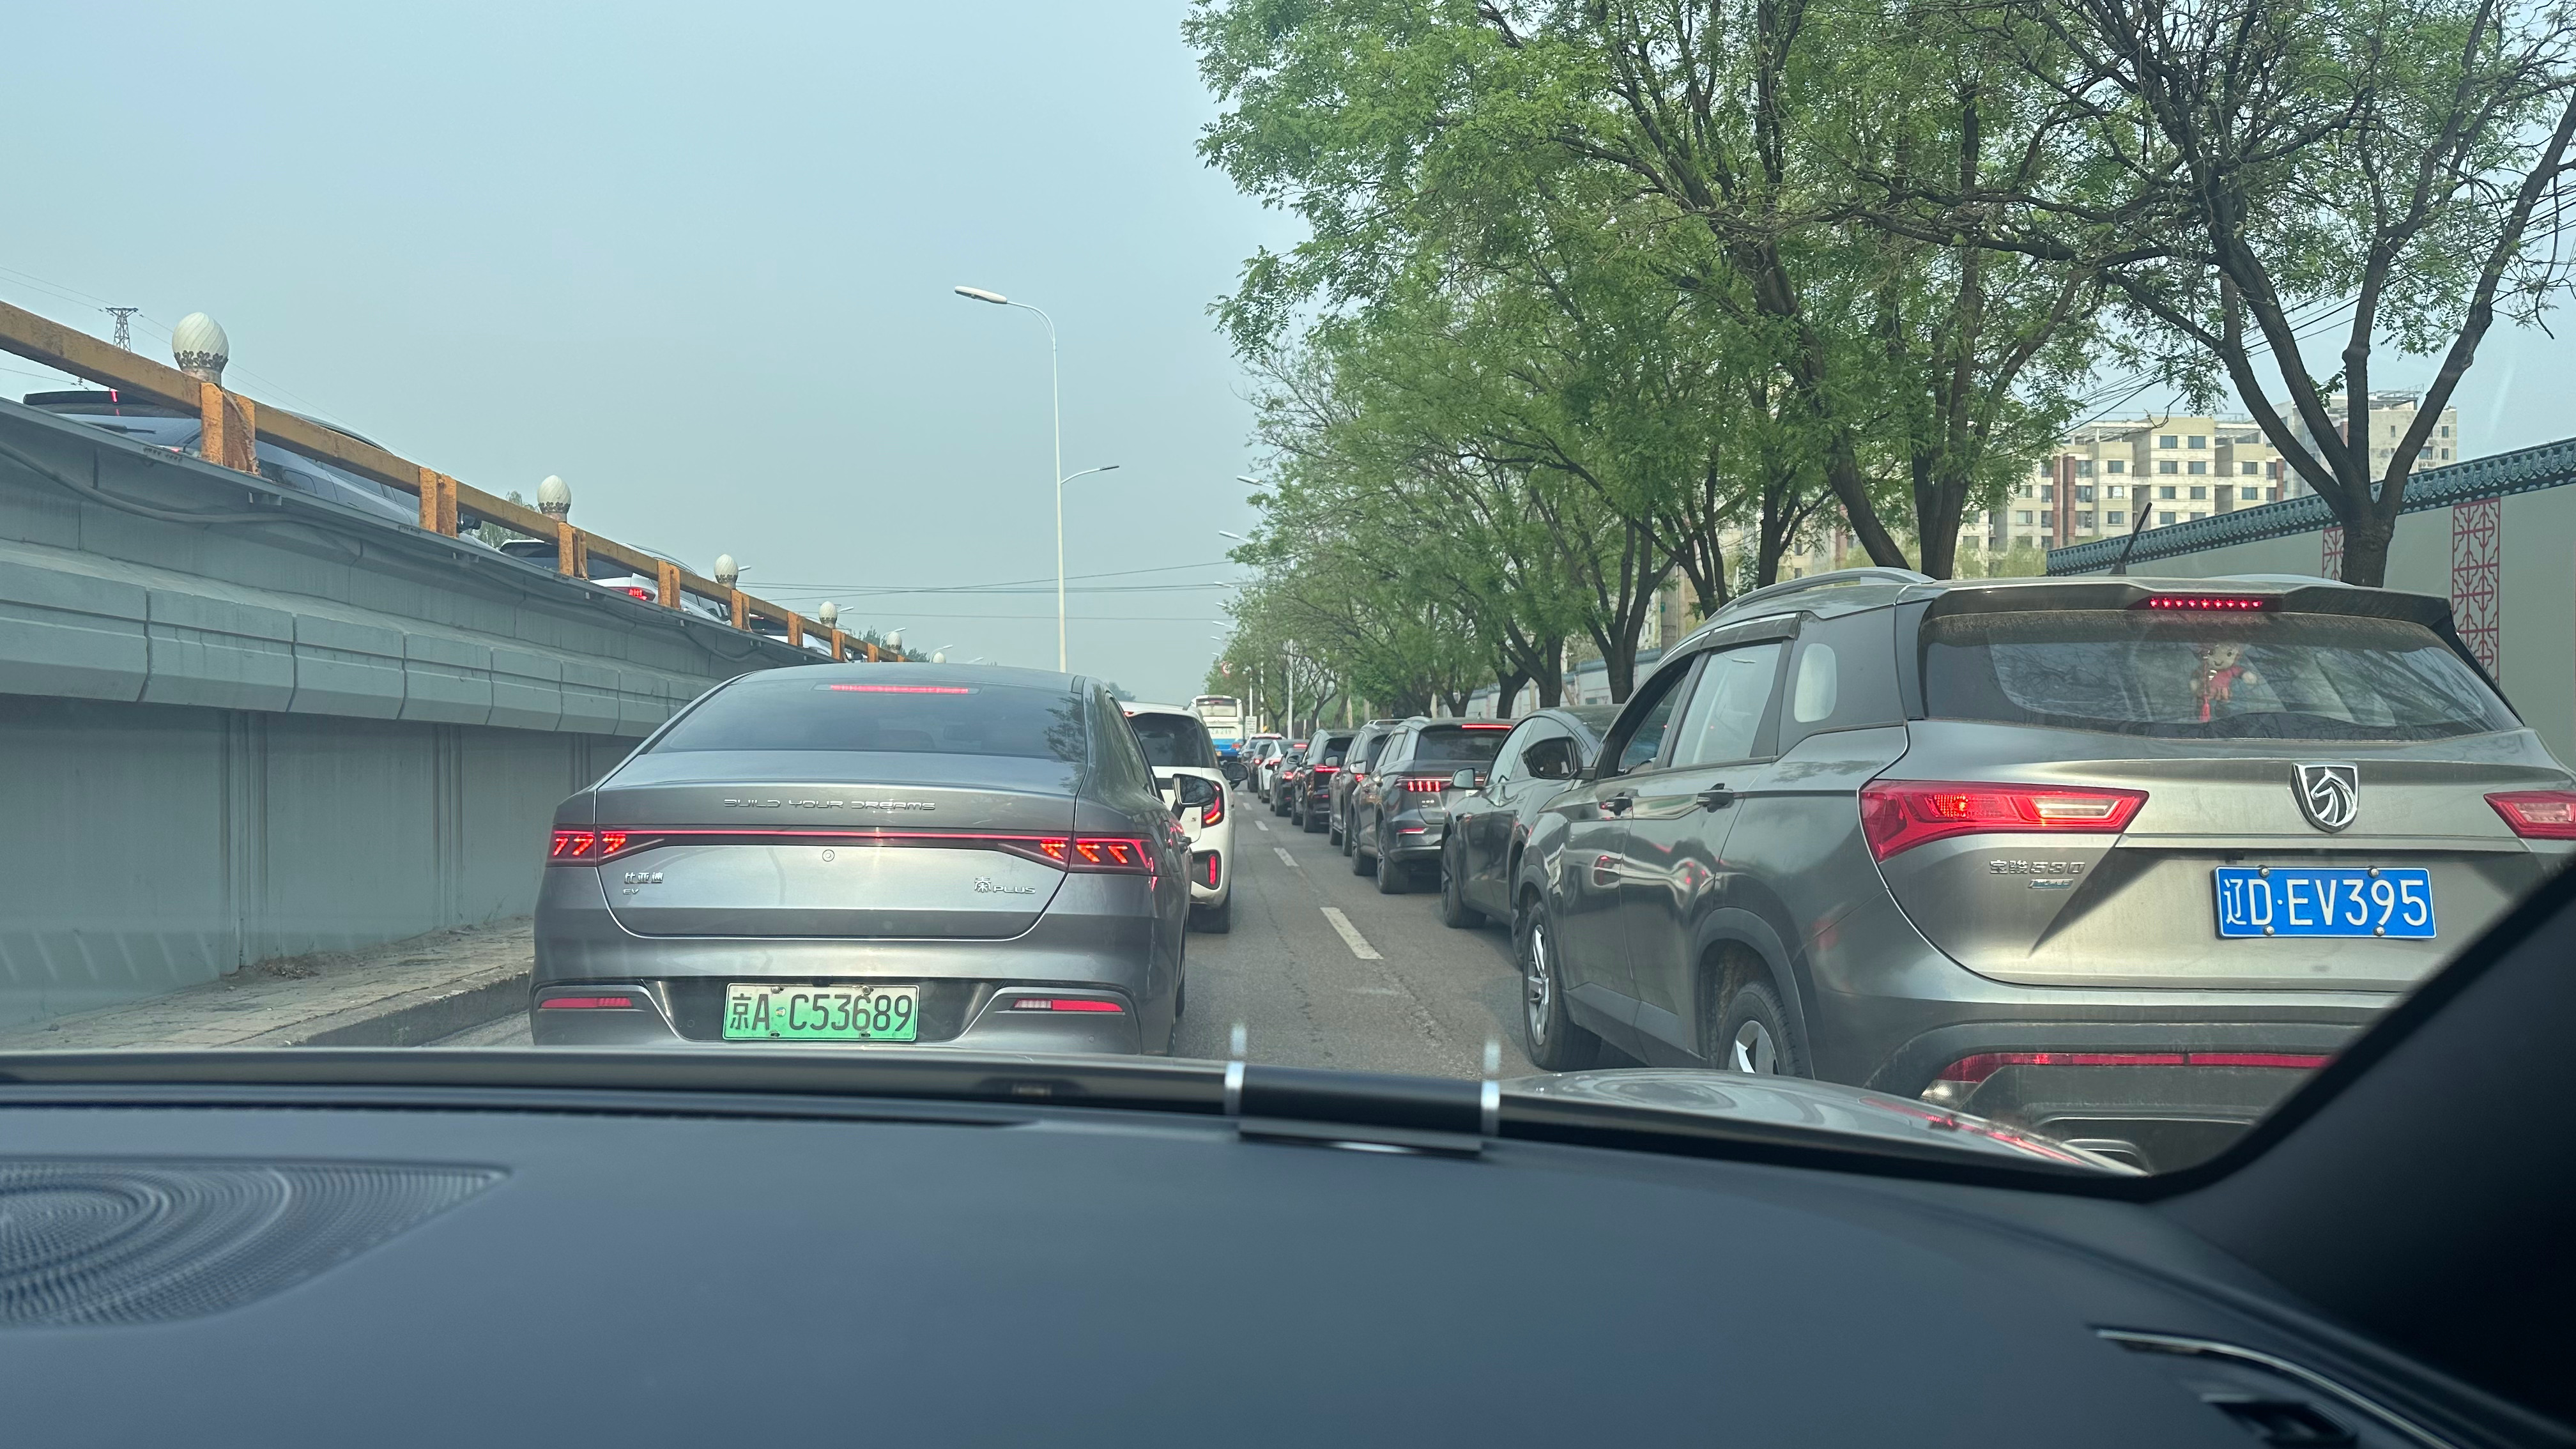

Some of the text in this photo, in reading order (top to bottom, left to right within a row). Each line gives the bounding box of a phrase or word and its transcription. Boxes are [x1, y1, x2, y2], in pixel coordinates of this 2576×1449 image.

[724, 799, 936, 810] BUILD YOUR DREAMS
[993, 885, 1036, 894] PLUS
